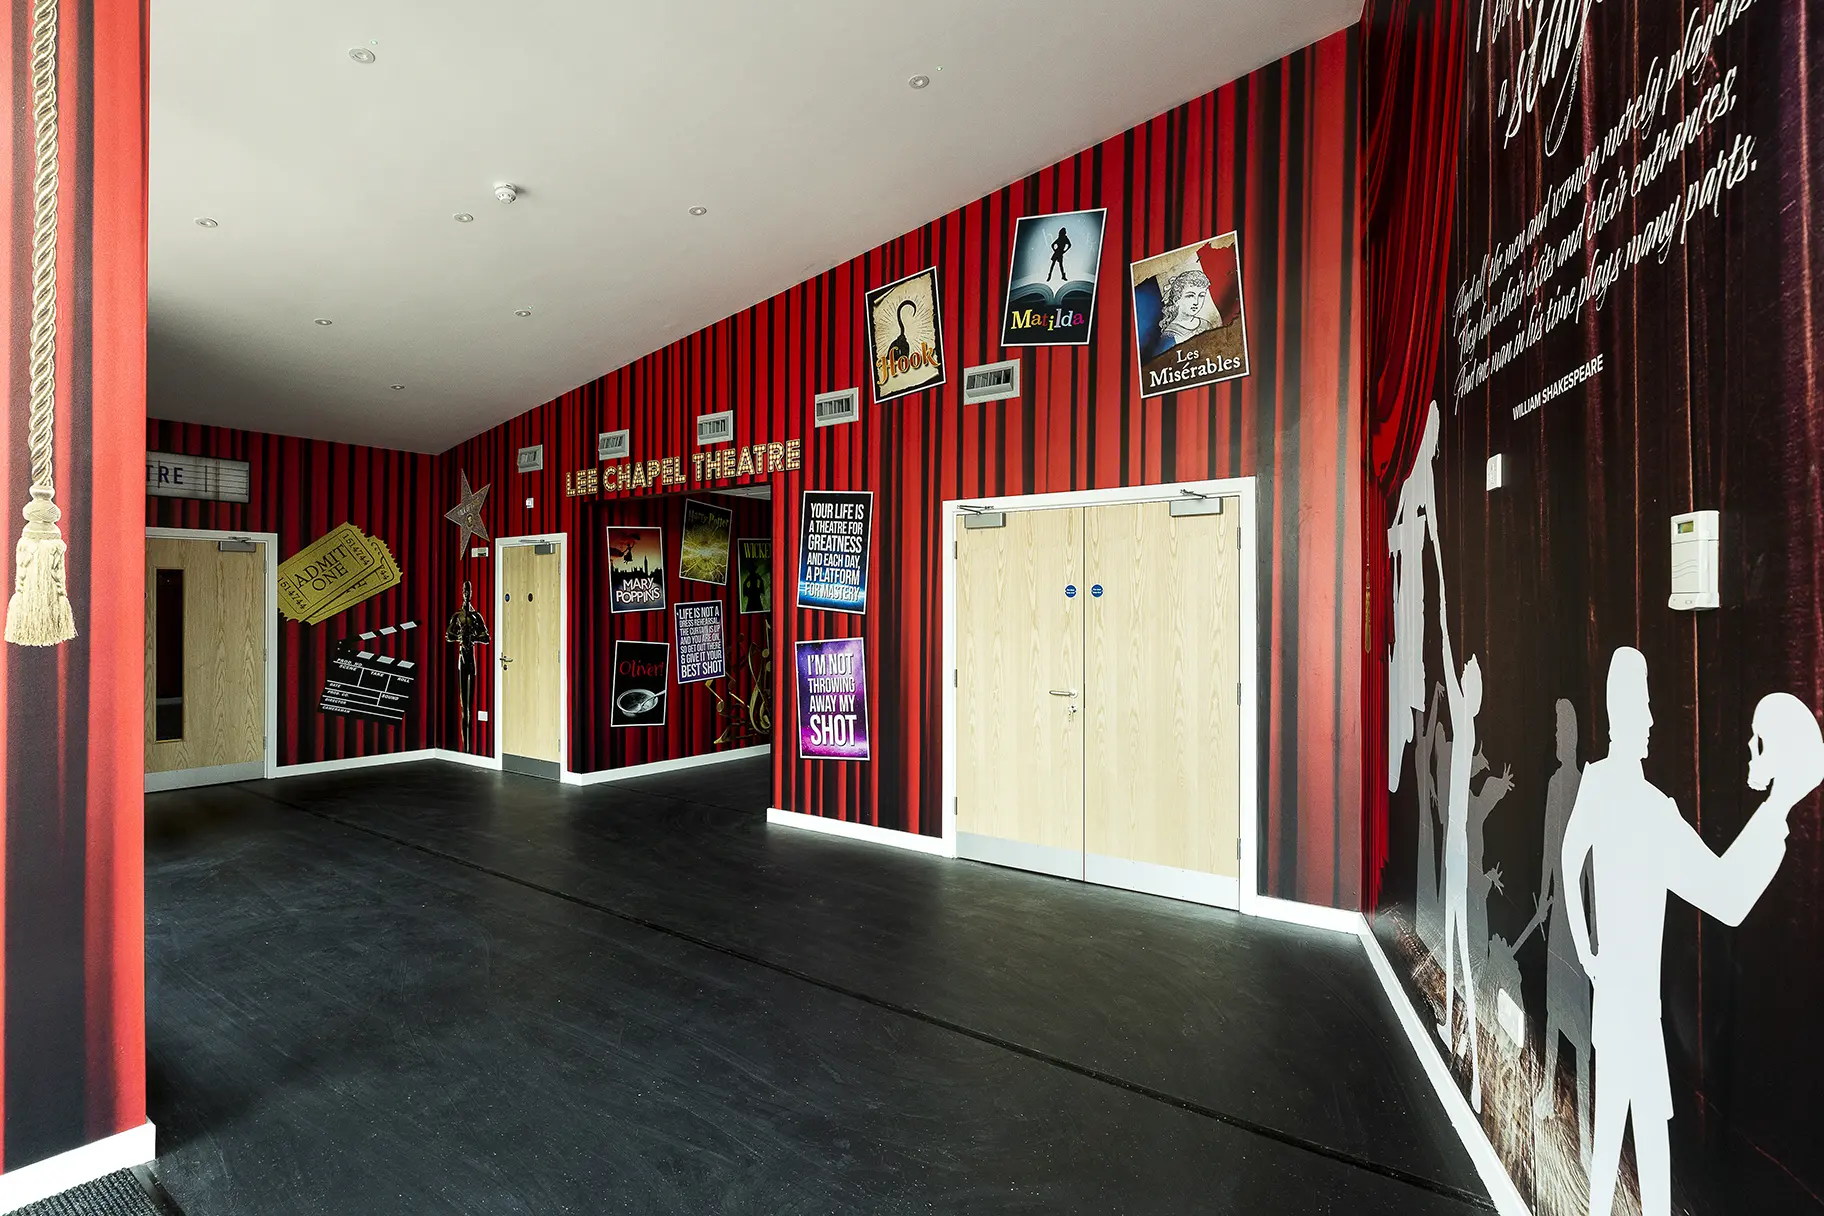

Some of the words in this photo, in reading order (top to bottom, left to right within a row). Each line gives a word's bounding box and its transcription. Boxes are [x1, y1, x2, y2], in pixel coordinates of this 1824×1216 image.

[1498, 78, 1508, 118] a
[1504, 0, 1603, 157] stag
[1452, 274, 1476, 337] And
[1488, 243, 1504, 288] the
[1504, 230, 1526, 269] men
[1527, 184, 1552, 246] and
[1552, 145, 1600, 219] women
[1602, 56, 1668, 165] merely
[1662, 0, 1757, 116] player
[1458, 311, 1479, 363] They
[1479, 303, 1499, 340] have
[1500, 269, 1525, 322] their
[1526, 243, 1556, 297] exits
[1557, 202, 1588, 267] and
[1587, 165, 1628, 241] their
[1630, 66, 1738, 198] entrances,
[1453, 357, 1477, 416] And
[1475, 358, 1490, 387] one
[1491, 340, 1512, 375] man
[1513, 320, 1525, 359] in
[1526, 302, 1544, 348] his
[1545, 285, 1577, 333] time
[1575, 248, 1623, 324] plays
[1624, 195, 1682, 270] many
[1681, 134, 1758, 244] parts.
[1010, 308, 1085, 331] Matilda
[876, 341, 942, 385] Hook
[1176, 349, 1200, 364] Les
[1149, 355, 1241, 388] Misérables
[1512, 391, 1541, 421] WILLIAM
[1542, 353, 1604, 404] SHAKESPEARE
[565, 467, 598, 497] LEE
[603, 456, 687, 492] CHAPEL
[692, 438, 801, 482] THEATRE
[810, 502, 834, 519] YOUR
[834, 503, 854, 520] LIFE
[854, 503, 865, 520] IS
[808, 519, 815, 533] A
[815, 520, 847, 535] THEATRE
[848, 521, 864, 535] FOR
[807, 534, 863, 554] GREATNESS
[294, 543, 348, 588] ADMIT
[806, 552, 823, 566] AND
[823, 553, 843, 568] EACH
[312, 562, 349, 591] ONE
[622, 577, 655, 592] MARY
[805, 566, 813, 581] A
[814, 566, 861, 586] PLATFORM
[615, 587, 661, 604] POPPINS
[804, 582, 822, 598] FOR
[679, 607, 693, 620] LIFE
[693, 606, 701, 619] IS
[701, 606, 714, 618] NOT
[714, 605, 720, 617] A
[679, 619, 694, 628] DRESS
[680, 627, 689, 637] THE
[689, 625, 708, 636] CURTAIN
[708, 625, 714, 634] IS
[714, 624, 720, 633] UP
[680, 636, 691, 645] AND
[691, 635, 701, 644] YOU
[701, 634, 712, 643] ARE
[680, 645, 688, 654] SO
[687, 644, 697, 653] GET
[696, 643, 706, 652] OUT
[706, 642, 721, 651] THERE
[686, 652, 699, 663] GIVE
[699, 651, 706, 661] IT
[706, 650, 722, 660] YOUR
[807, 653, 827, 676] I'M
[829, 652, 854, 676] NOT
[619, 659, 665, 678] Oliver!
[681, 663, 701, 679] BEST
[702, 660, 722, 675] SHOT
[807, 676, 856, 694] THROWING
[809, 694, 837, 713] AWAY
[839, 694, 856, 713] MY
[809, 713, 858, 747] SHOT
